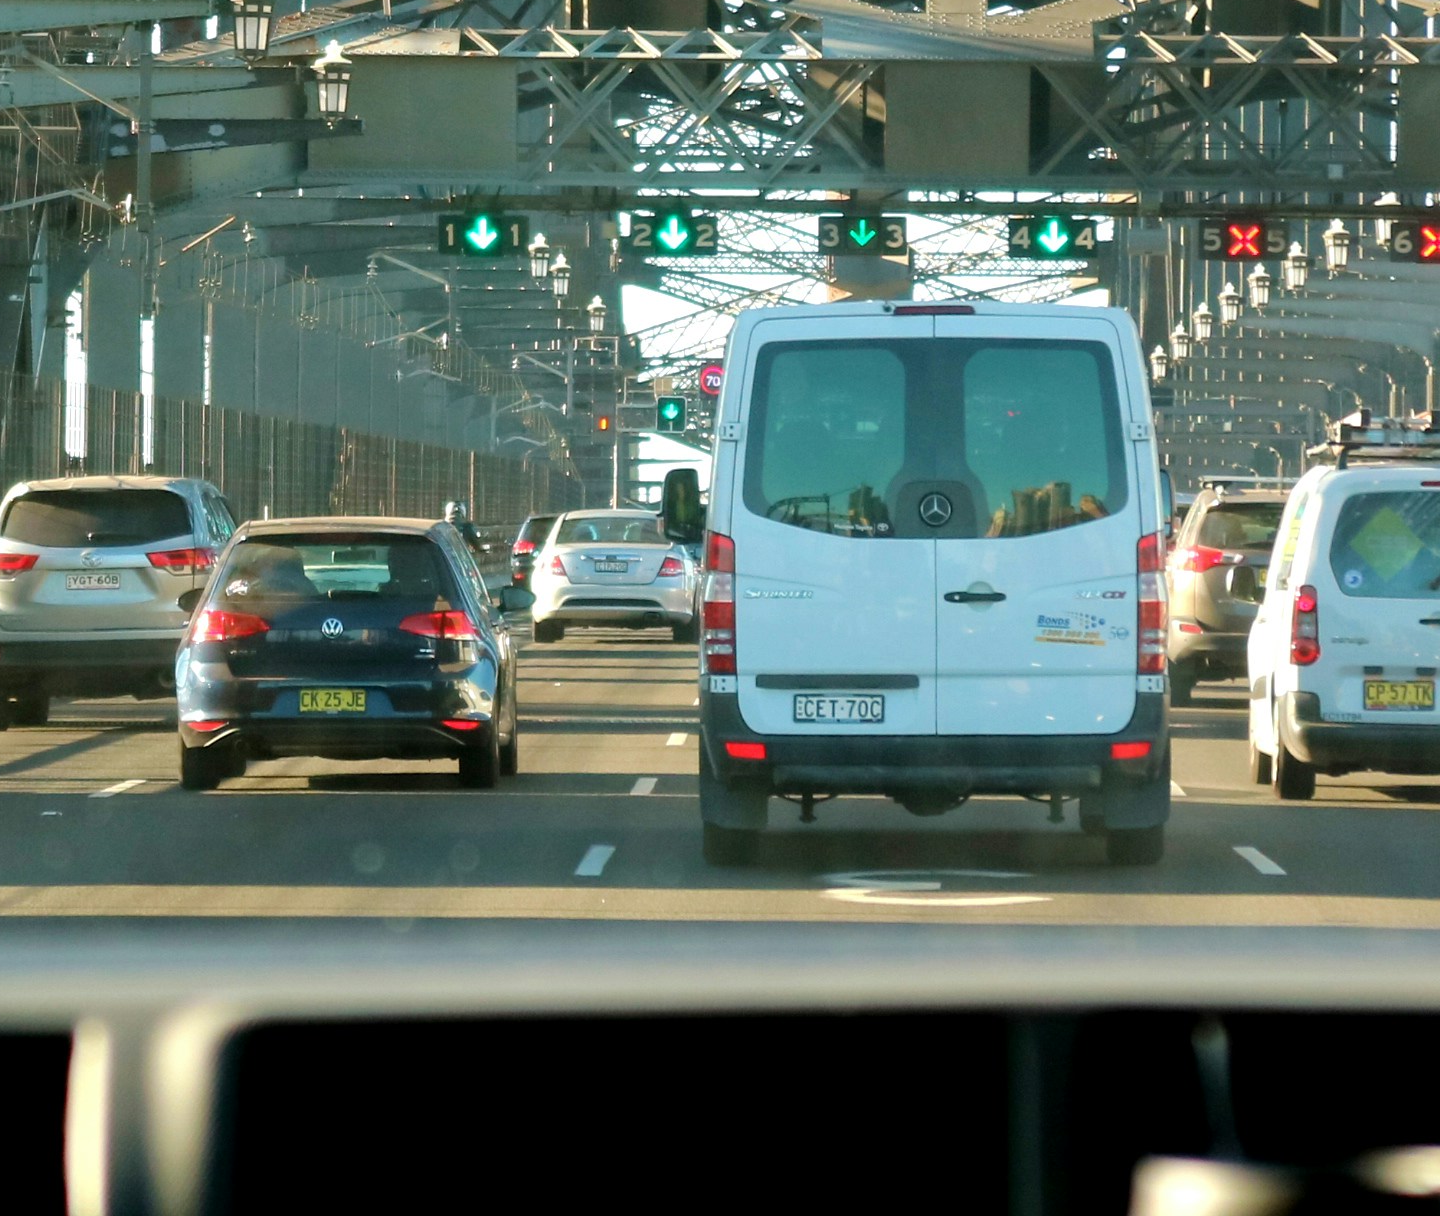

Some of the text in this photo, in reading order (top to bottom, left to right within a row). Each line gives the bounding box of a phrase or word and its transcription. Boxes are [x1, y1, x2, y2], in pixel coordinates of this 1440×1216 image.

[445, 223, 519, 246] 1 1
[633, 223, 714, 247] 2 2
[821, 224, 904, 248] 3 3
[1011, 225, 1095, 250] 4 4
[1203, 228, 1286, 252] 5 5
[1393, 230, 1413, 253] 6
[706, 375, 721, 387] 70
